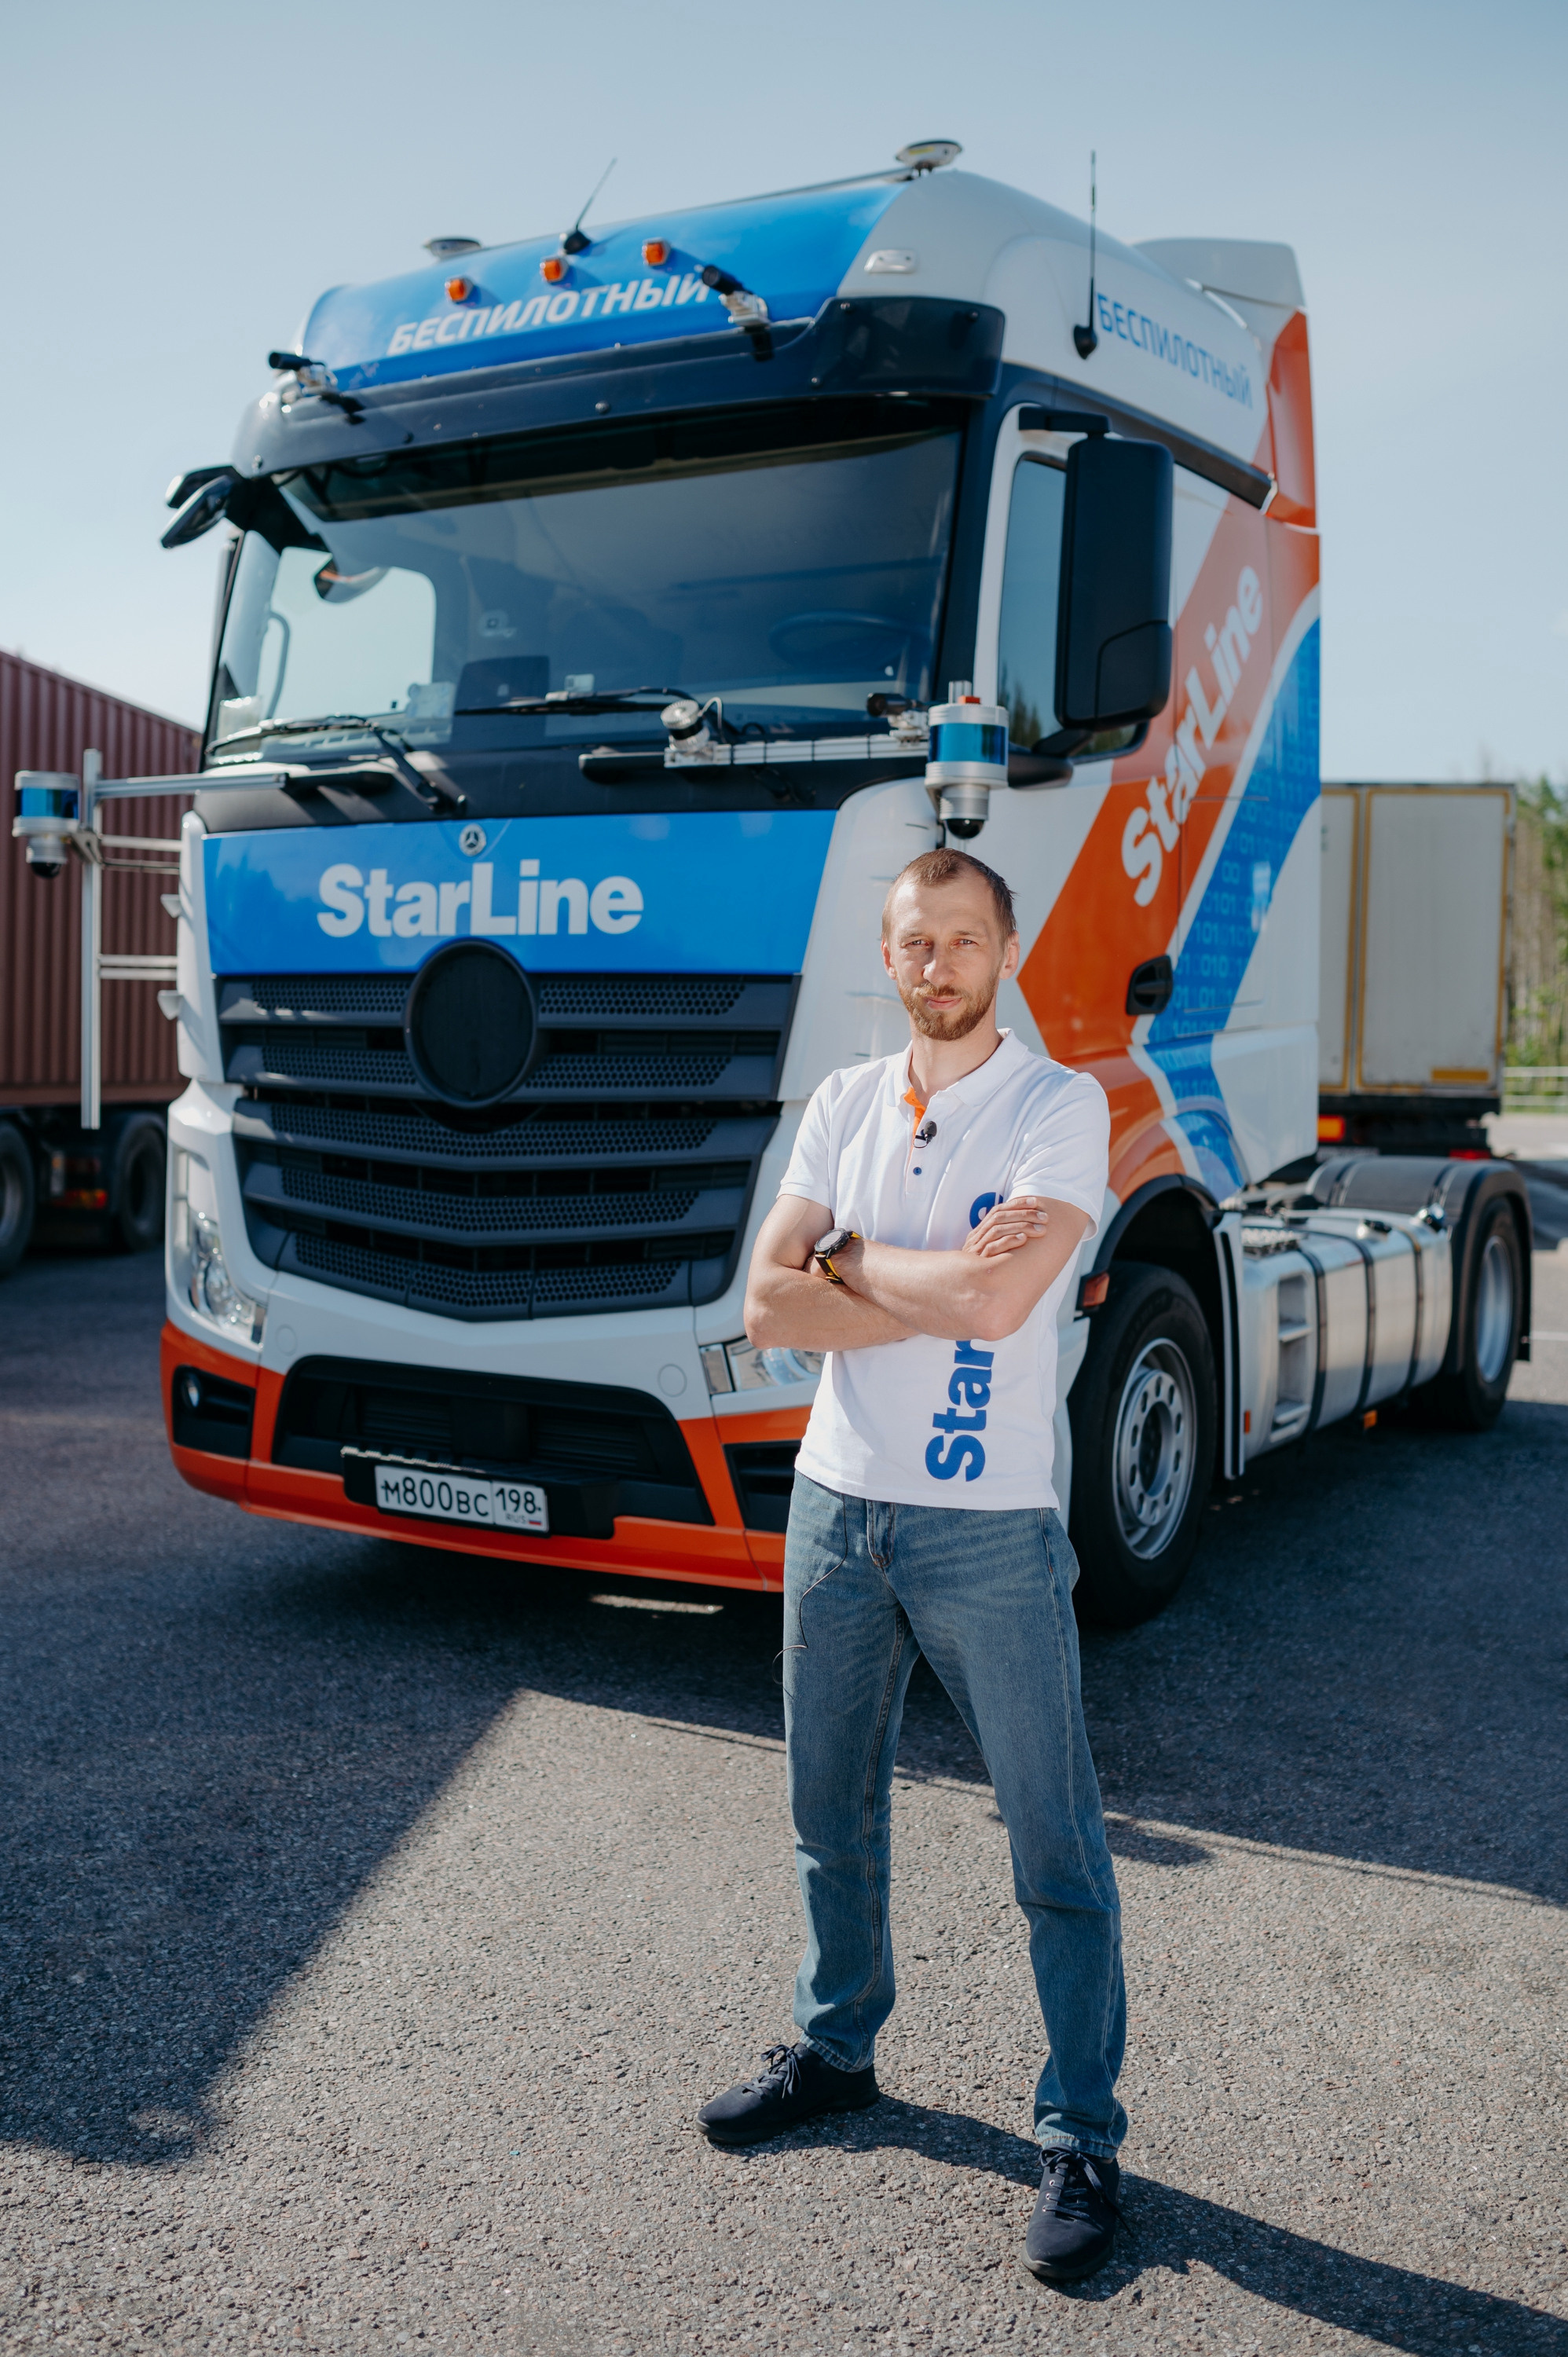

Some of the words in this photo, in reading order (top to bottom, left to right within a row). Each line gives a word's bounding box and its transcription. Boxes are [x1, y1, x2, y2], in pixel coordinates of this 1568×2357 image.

[387, 271, 709, 357] БЕСПИЛОТНЫЙ
[1097, 292, 1254, 410] БЕСПИЛОТНЫЙ
[1122, 565, 1262, 907] StarLine
[317, 859, 644, 938] StarLine
[505, 1512, 526, 1524] RUS
